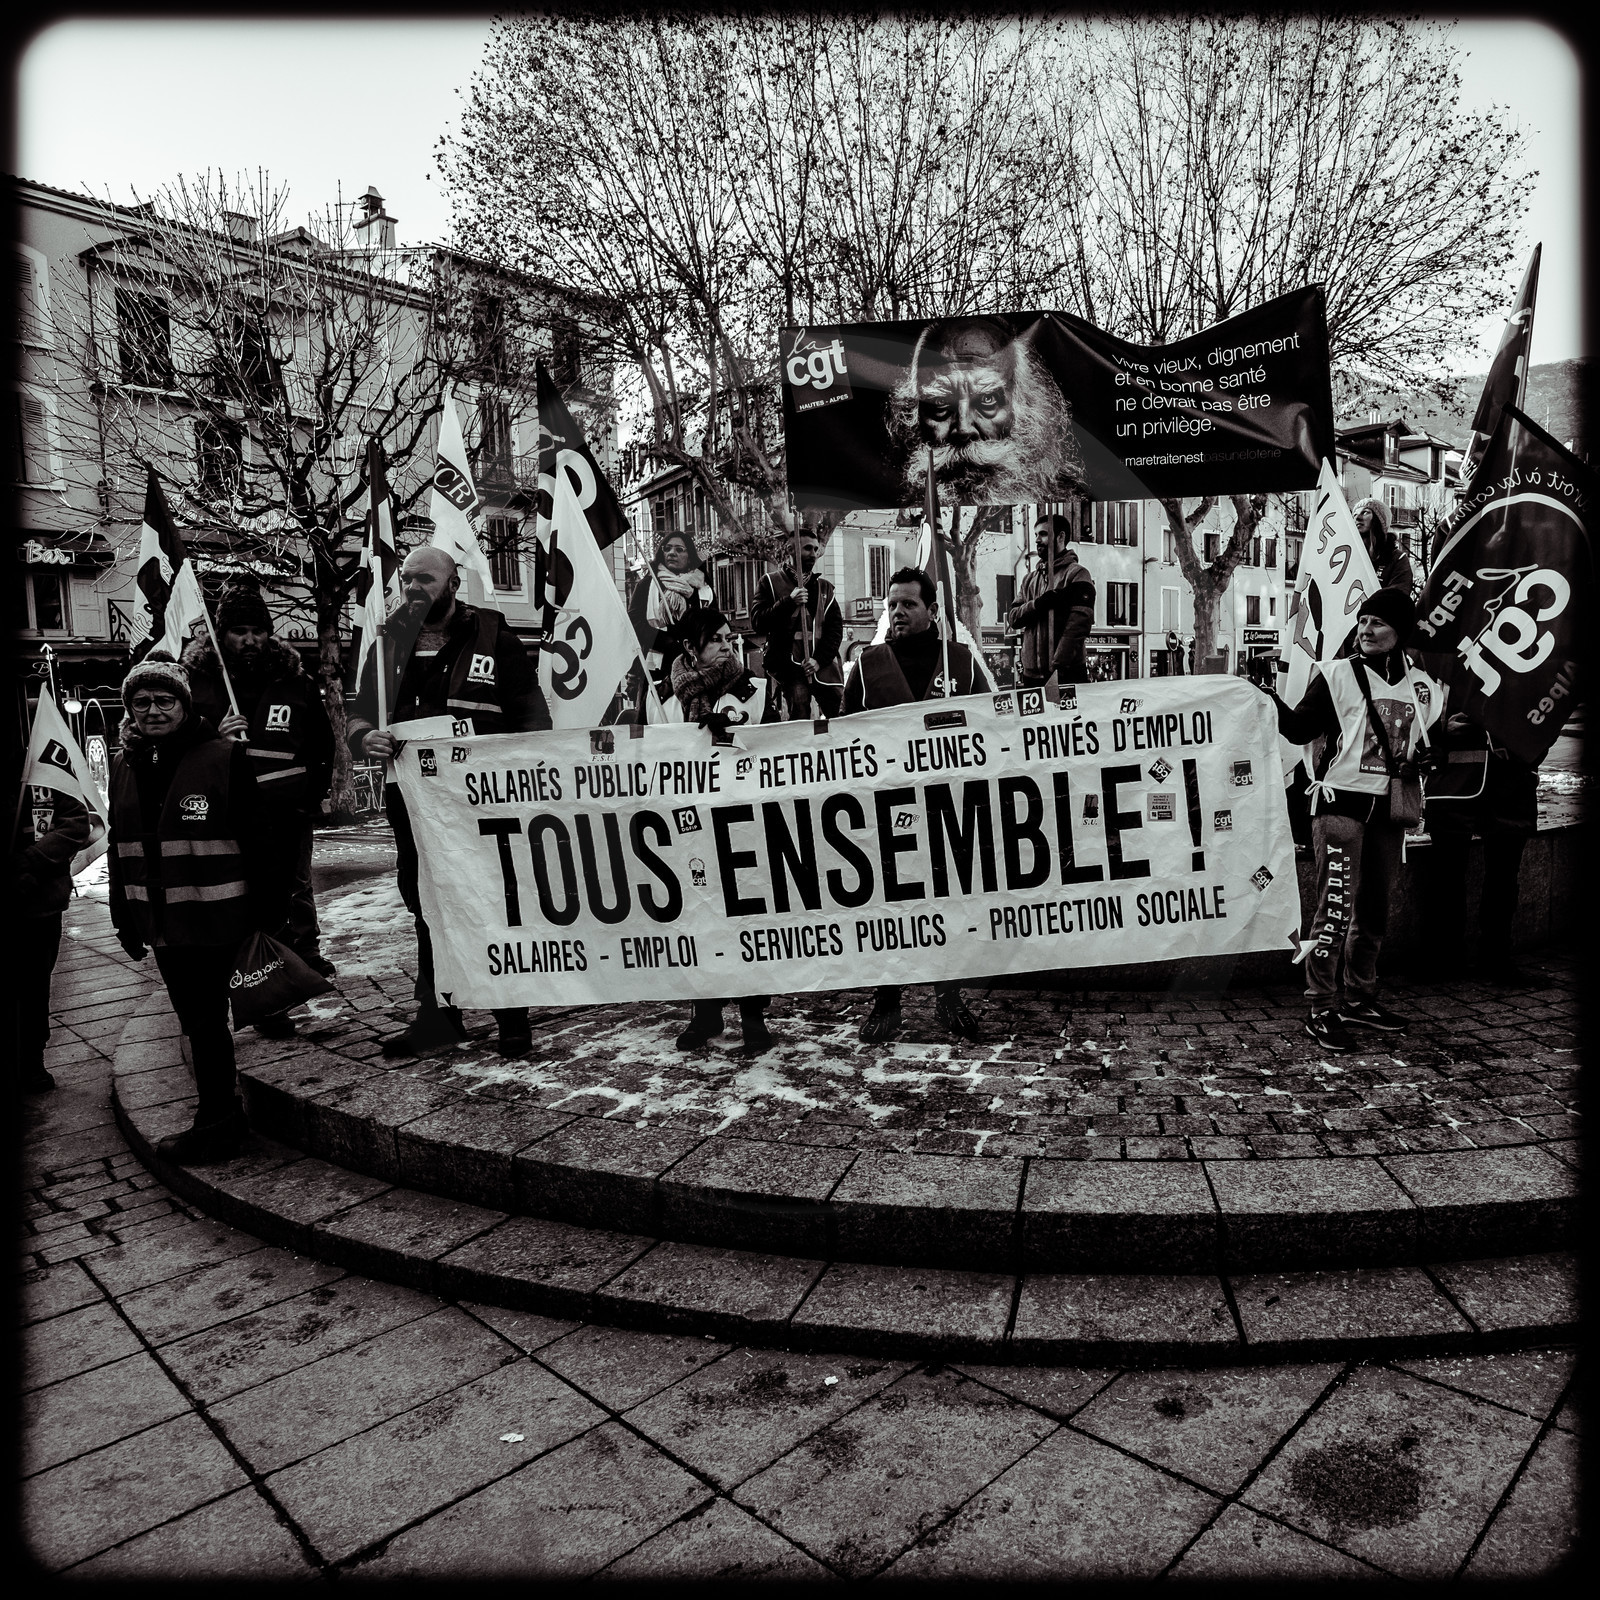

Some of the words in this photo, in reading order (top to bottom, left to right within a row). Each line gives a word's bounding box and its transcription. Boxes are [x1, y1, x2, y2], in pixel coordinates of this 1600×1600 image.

[1153, 356, 1202, 374] vieux,
[1207, 332, 1300, 366] dignement
[786, 339, 847, 390] cgt
[1115, 372, 1131, 386] et
[1136, 377, 1156, 389] en
[1160, 379, 1214, 392] bonne
[1219, 365, 1266, 389] santé
[799, 400, 824, 410] HAUTES
[829, 394, 849, 404] ALPES
[1115, 397, 1136, 411] ne
[1142, 393, 1197, 410] devrait
[1201, 399, 1232, 412] pas
[1238, 394, 1271, 411] être
[1116, 422, 1137, 437] un
[1143, 415, 1216, 439] privilège.
[24, 540, 70, 564] Bar
[857, 600, 872, 610] DH
[995, 698, 1014, 710] cgt
[1022, 692, 1040, 710] FO
[1060, 697, 1078, 709] cgt
[267, 705, 291, 726] FO
[465, 760, 562, 806] SALARIÉS
[574, 751, 721, 799] PUBLIC/PRIVÉ
[760, 738, 878, 789] RETRAITÉS
[904, 732, 987, 774] JEUNES
[1022, 715, 1100, 761] PRIVÉS
[1113, 710, 1213, 752] D'EMPLOI
[1234, 772, 1253, 785] cgt
[679, 810, 695, 828] FO
[1214, 815, 1233, 827] cgt
[478, 810, 684, 927] TOUS
[711, 763, 1152, 918] ENSEMBLE
[1343, 856, 1351, 895] FIELD
[1315, 844, 1343, 958] SUPERDRY
[487, 940, 588, 976] SALAIRES
[620, 935, 698, 969] EMPLOI
[739, 924, 843, 963] SERVICES
[855, 913, 947, 953] PUBLICS
[990, 895, 1124, 940] PROTECTION
[1137, 885, 1227, 927] SOCIALE
